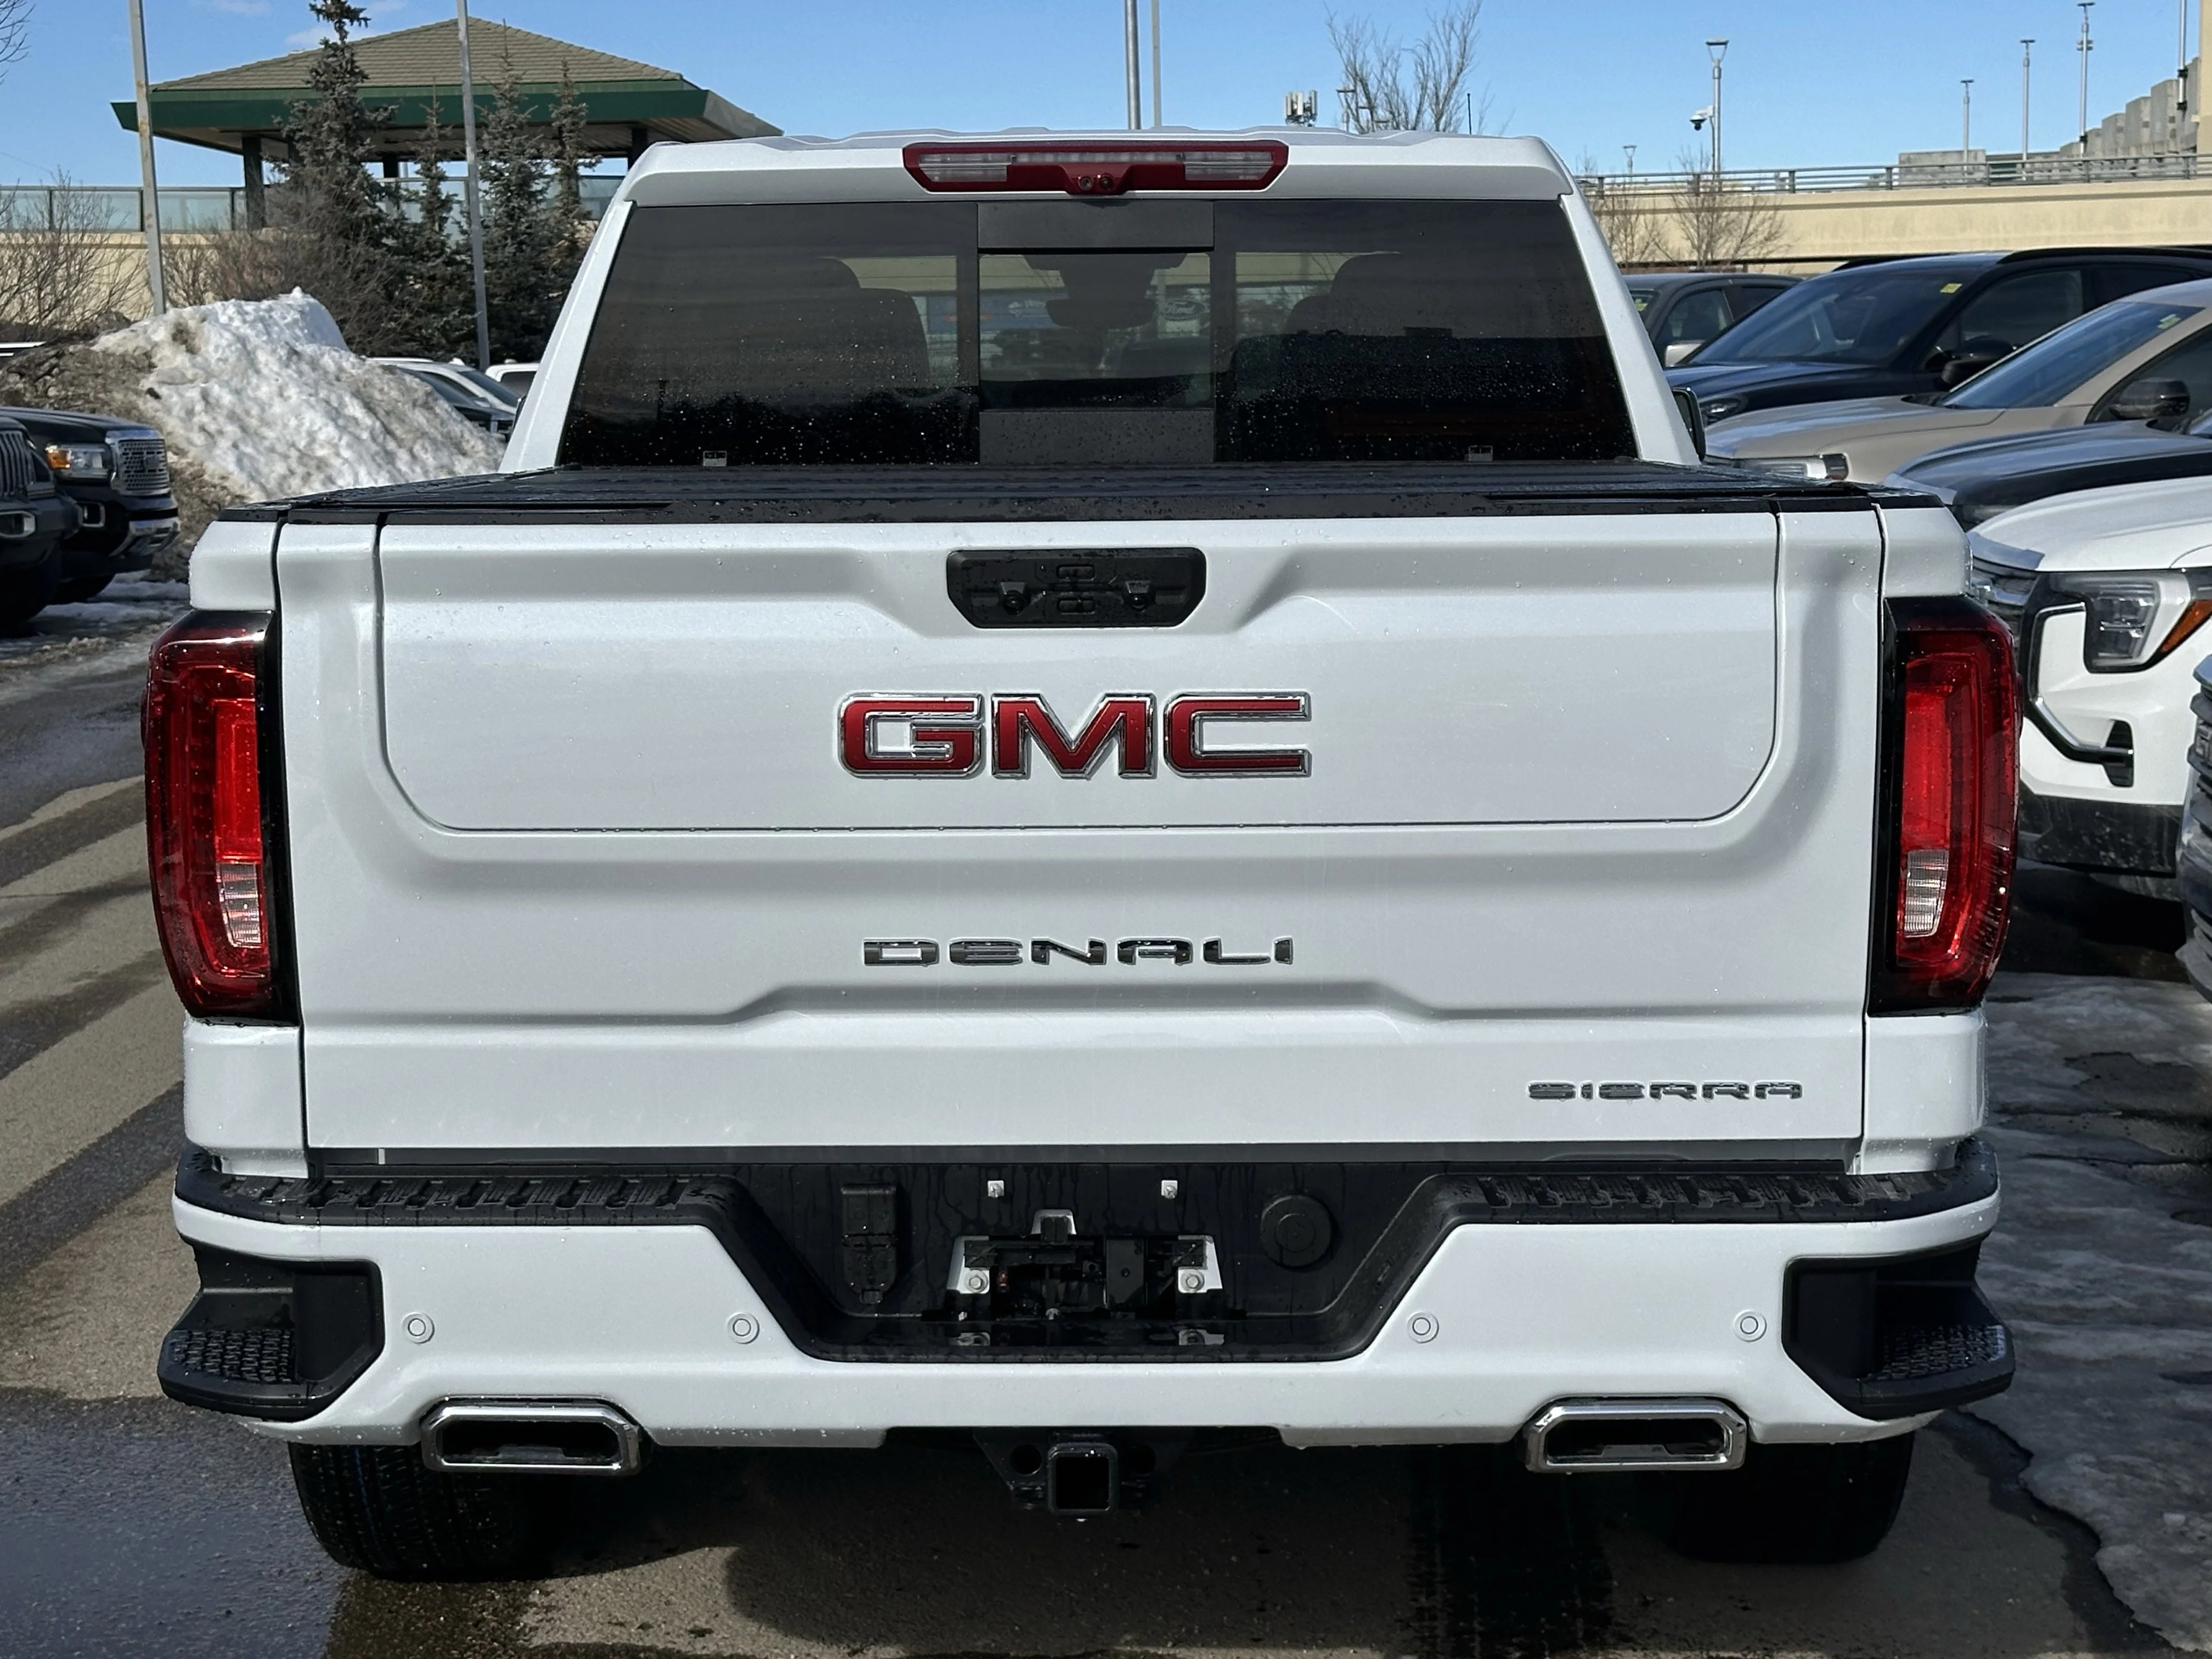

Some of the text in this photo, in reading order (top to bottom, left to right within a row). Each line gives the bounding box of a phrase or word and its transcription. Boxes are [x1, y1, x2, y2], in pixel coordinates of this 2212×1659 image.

[839, 693, 1311, 778] GMC
[863, 938, 1294, 966] DENALI
[1528, 1081, 1803, 1100] SIERRA
